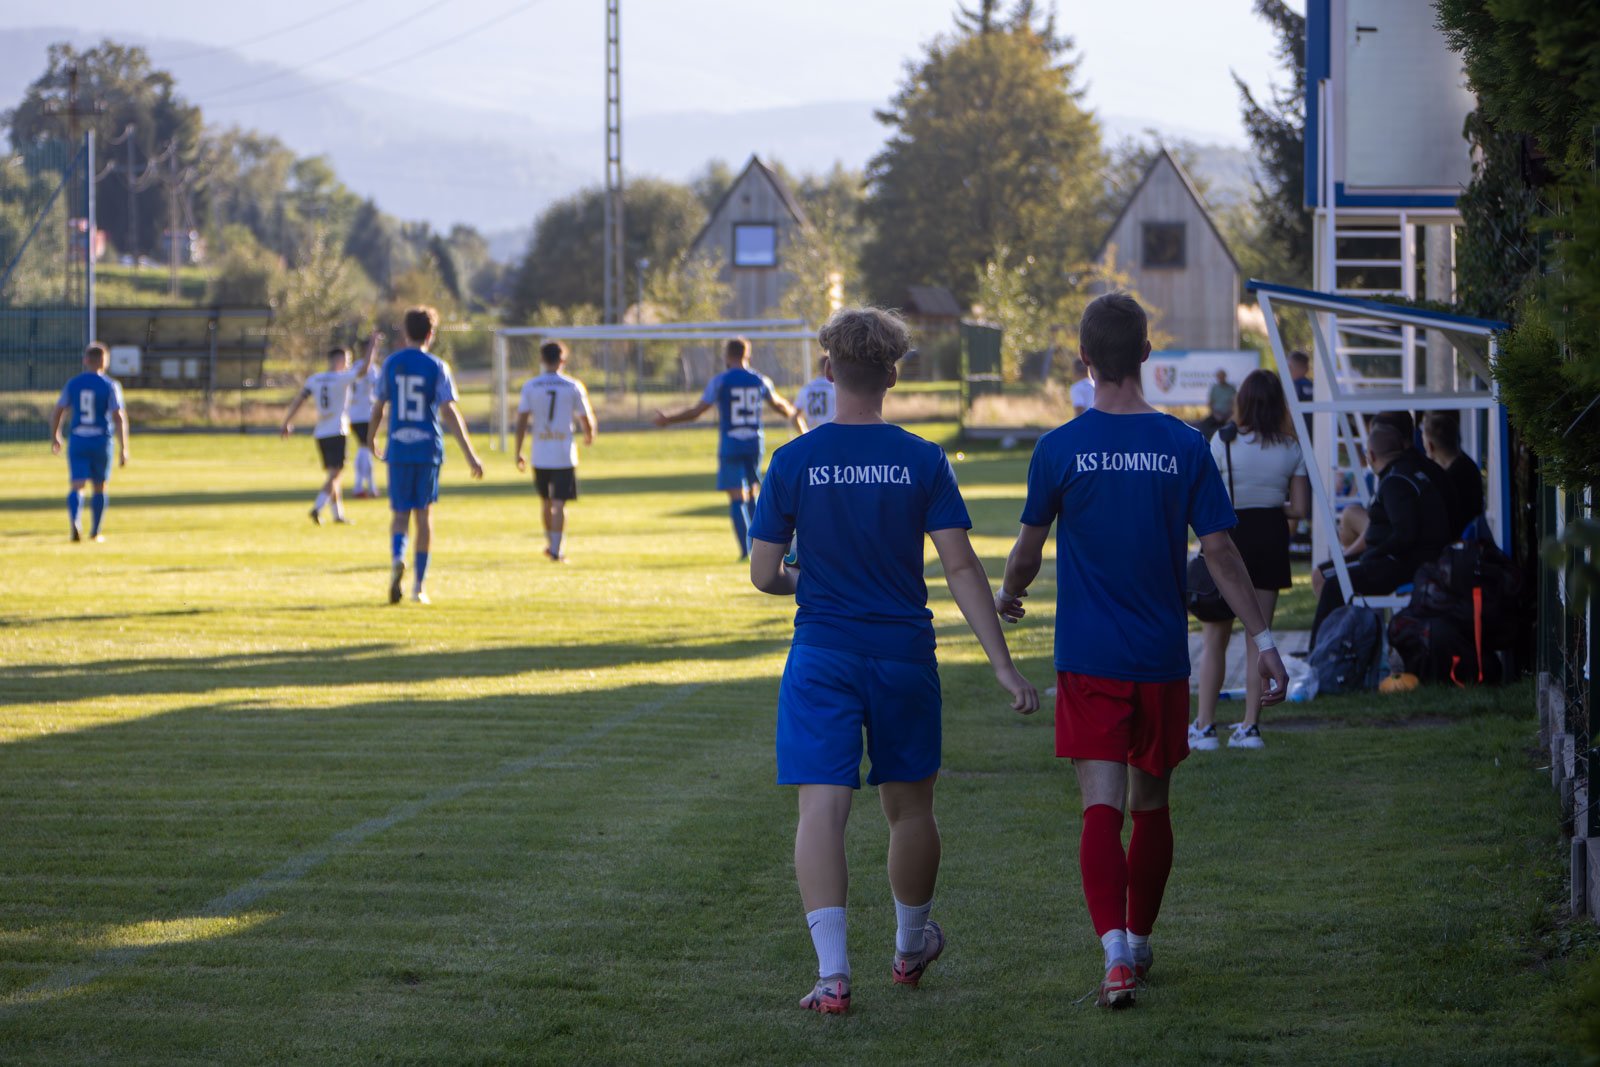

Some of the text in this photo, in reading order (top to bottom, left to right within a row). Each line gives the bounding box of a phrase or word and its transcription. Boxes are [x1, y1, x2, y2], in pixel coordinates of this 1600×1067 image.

[80, 389, 95, 424] 9
[395, 375, 425, 421] 15
[546, 390, 556, 421] 7
[730, 387, 759, 425] 29
[808, 465, 911, 485] KS ŁOMNICA
[1076, 452, 1179, 475] KS ŁOMNICA
